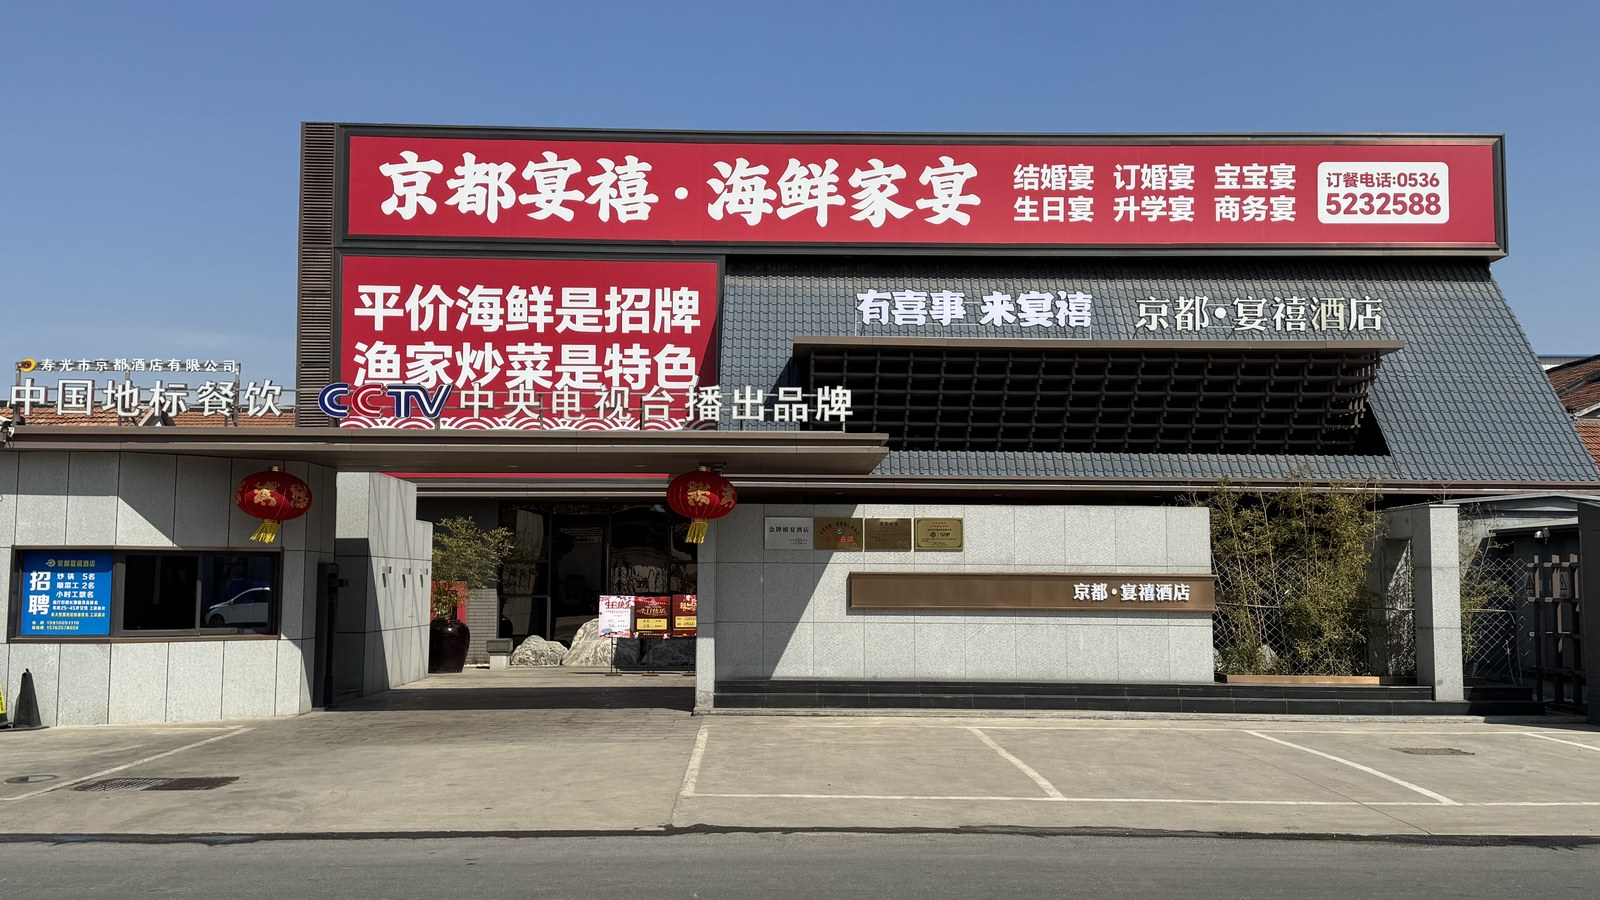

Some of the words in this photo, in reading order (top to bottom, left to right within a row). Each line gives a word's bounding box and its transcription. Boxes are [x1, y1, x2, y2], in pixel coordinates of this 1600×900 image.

[1013, 163, 1095, 191] 结婚宴
[1113, 163, 1195, 191] 订婚宴
[1214, 163, 1297, 190] 宝宝宴
[1326, 172, 1440, 188] 订餐电话:0536
[1013, 195, 1095, 222] 生日宴
[1113, 195, 1195, 222] 升学宴
[1214, 195, 1297, 222] 商务宴
[1326, 192, 1442, 216] 5232588
[354, 284, 701, 334] 平价海鲜是招牌
[856, 289, 967, 326] 有喜事
[979, 290, 1093, 327] 来宴禧
[1135, 296, 1383, 332] 京都·宴禧酒店
[41, 358, 237, 373] 寿光市京都酒店有限公司
[353, 341, 700, 390] 渔家炒菜是特色
[10, 378, 284, 417] 中国地标餐饮
[317, 382, 453, 418] CCTV
[460, 382, 853, 422] 中央电视台播出品牌
[28, 571, 51, 615] 招聘
[1073, 583, 1190, 602] 京都·宴禧酒店
